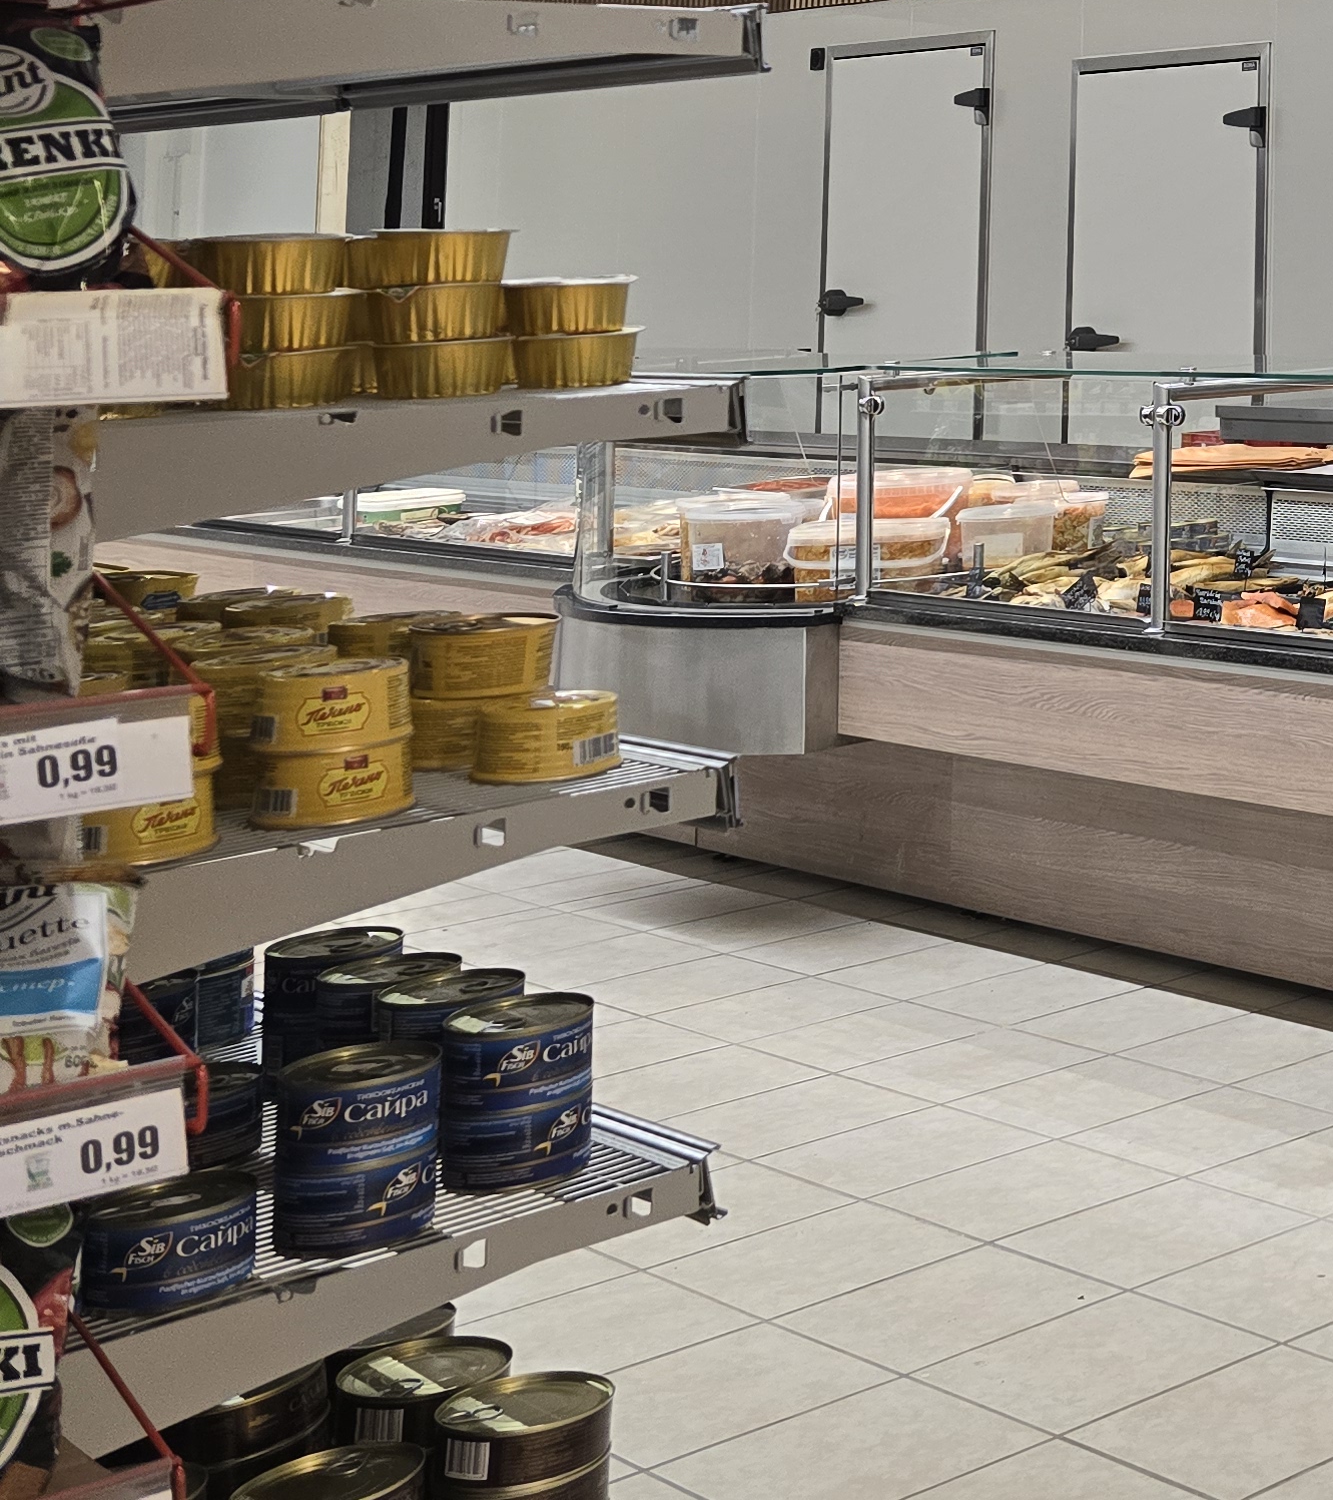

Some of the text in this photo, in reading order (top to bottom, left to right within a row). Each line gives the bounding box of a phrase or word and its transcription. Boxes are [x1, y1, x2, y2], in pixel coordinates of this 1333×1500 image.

[37, 745, 118, 789] 0,99
[343, 1089, 429, 1124] Сайра
[80, 1125, 160, 1174] 0,99
[175, 1216, 254, 1258] Сайра
